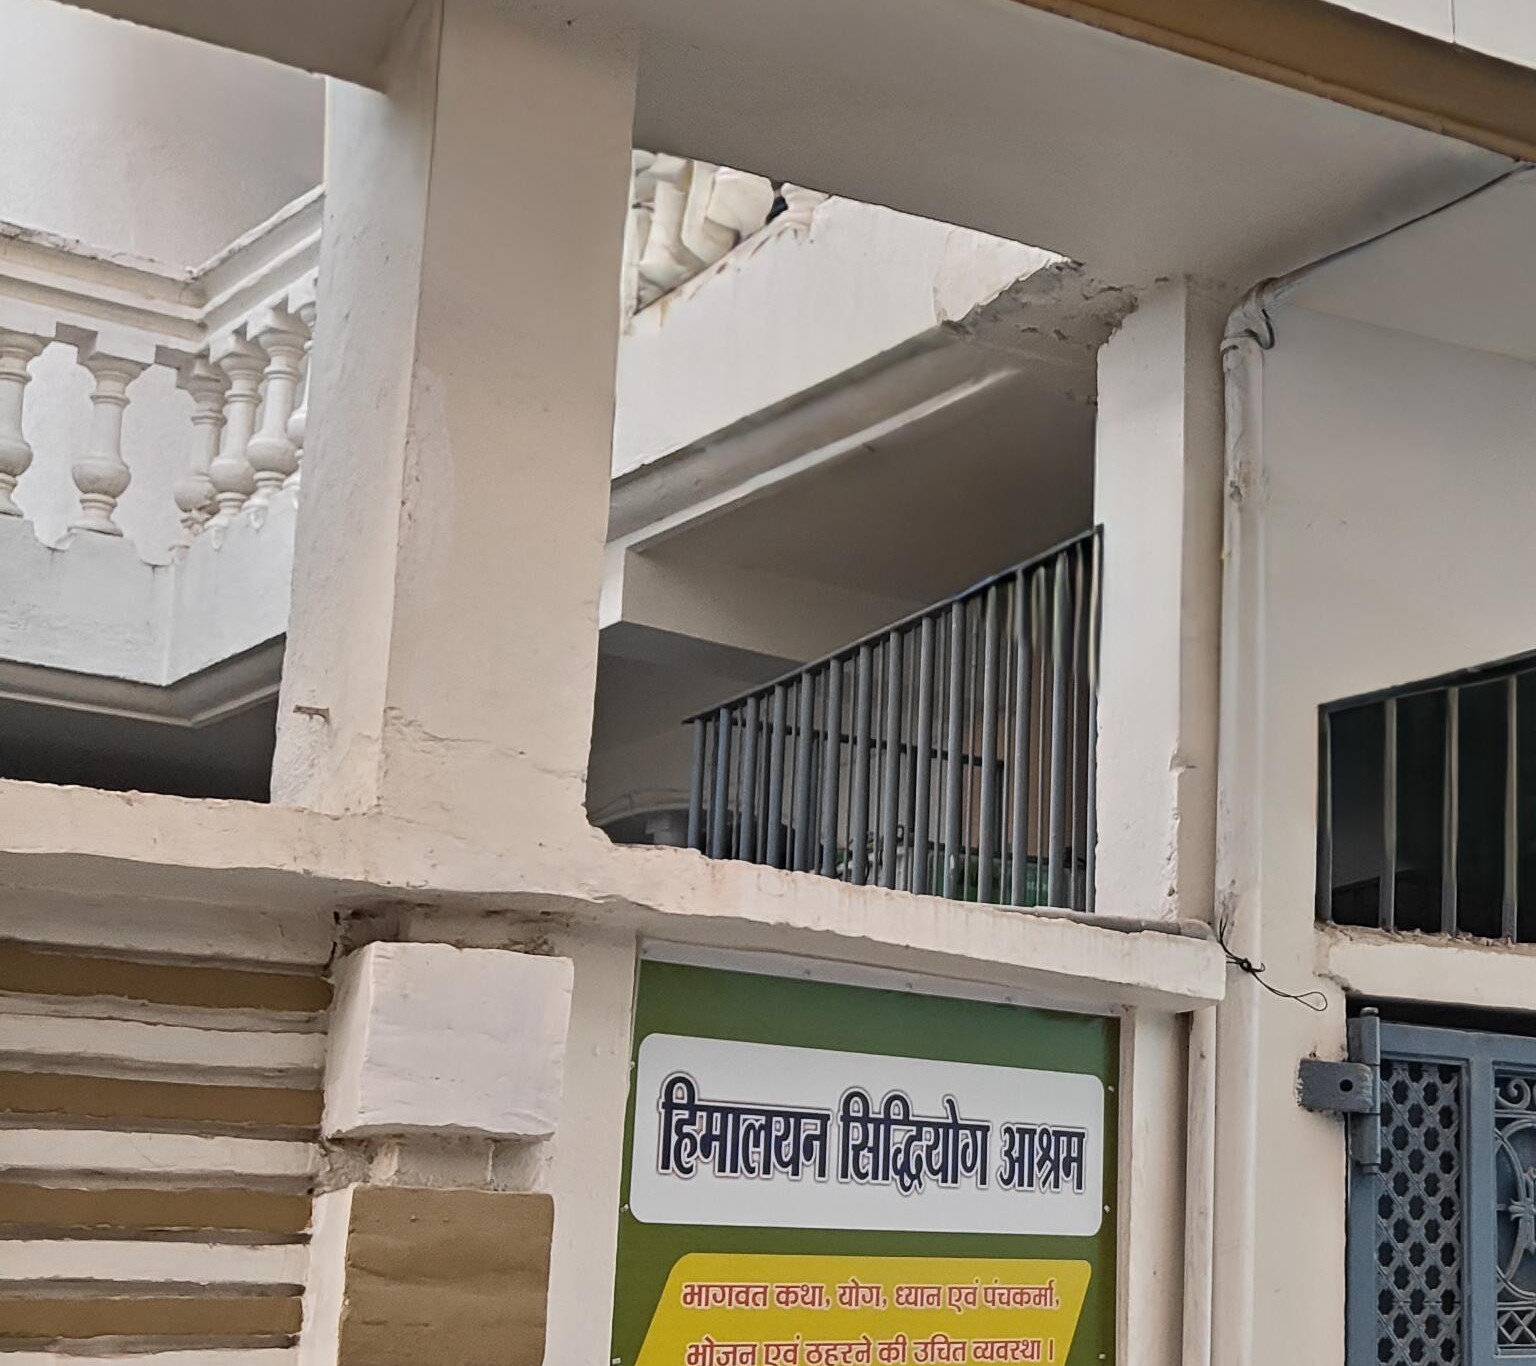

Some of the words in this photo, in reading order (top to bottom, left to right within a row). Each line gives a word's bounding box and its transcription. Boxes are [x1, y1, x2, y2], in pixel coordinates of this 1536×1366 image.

[660, 1073, 832, 1179] हिमालयन
[838, 1088, 989, 1194] सिद्धियोग
[998, 1123, 1086, 1192] आश्रम
[682, 1284, 769, 1307] भागवत
[774, 1283, 831, 1308] कथा,
[838, 1277, 887, 1309] योग,
[895, 1285, 941, 1307] ध्यान
[948, 1279, 979, 1313] एवं
[688, 1335, 757, 1366] भोजन
[804, 1334, 871, 1366] ठहरने
[878, 1333, 908, 1363] की
[913, 1333, 967, 1363] उचित
